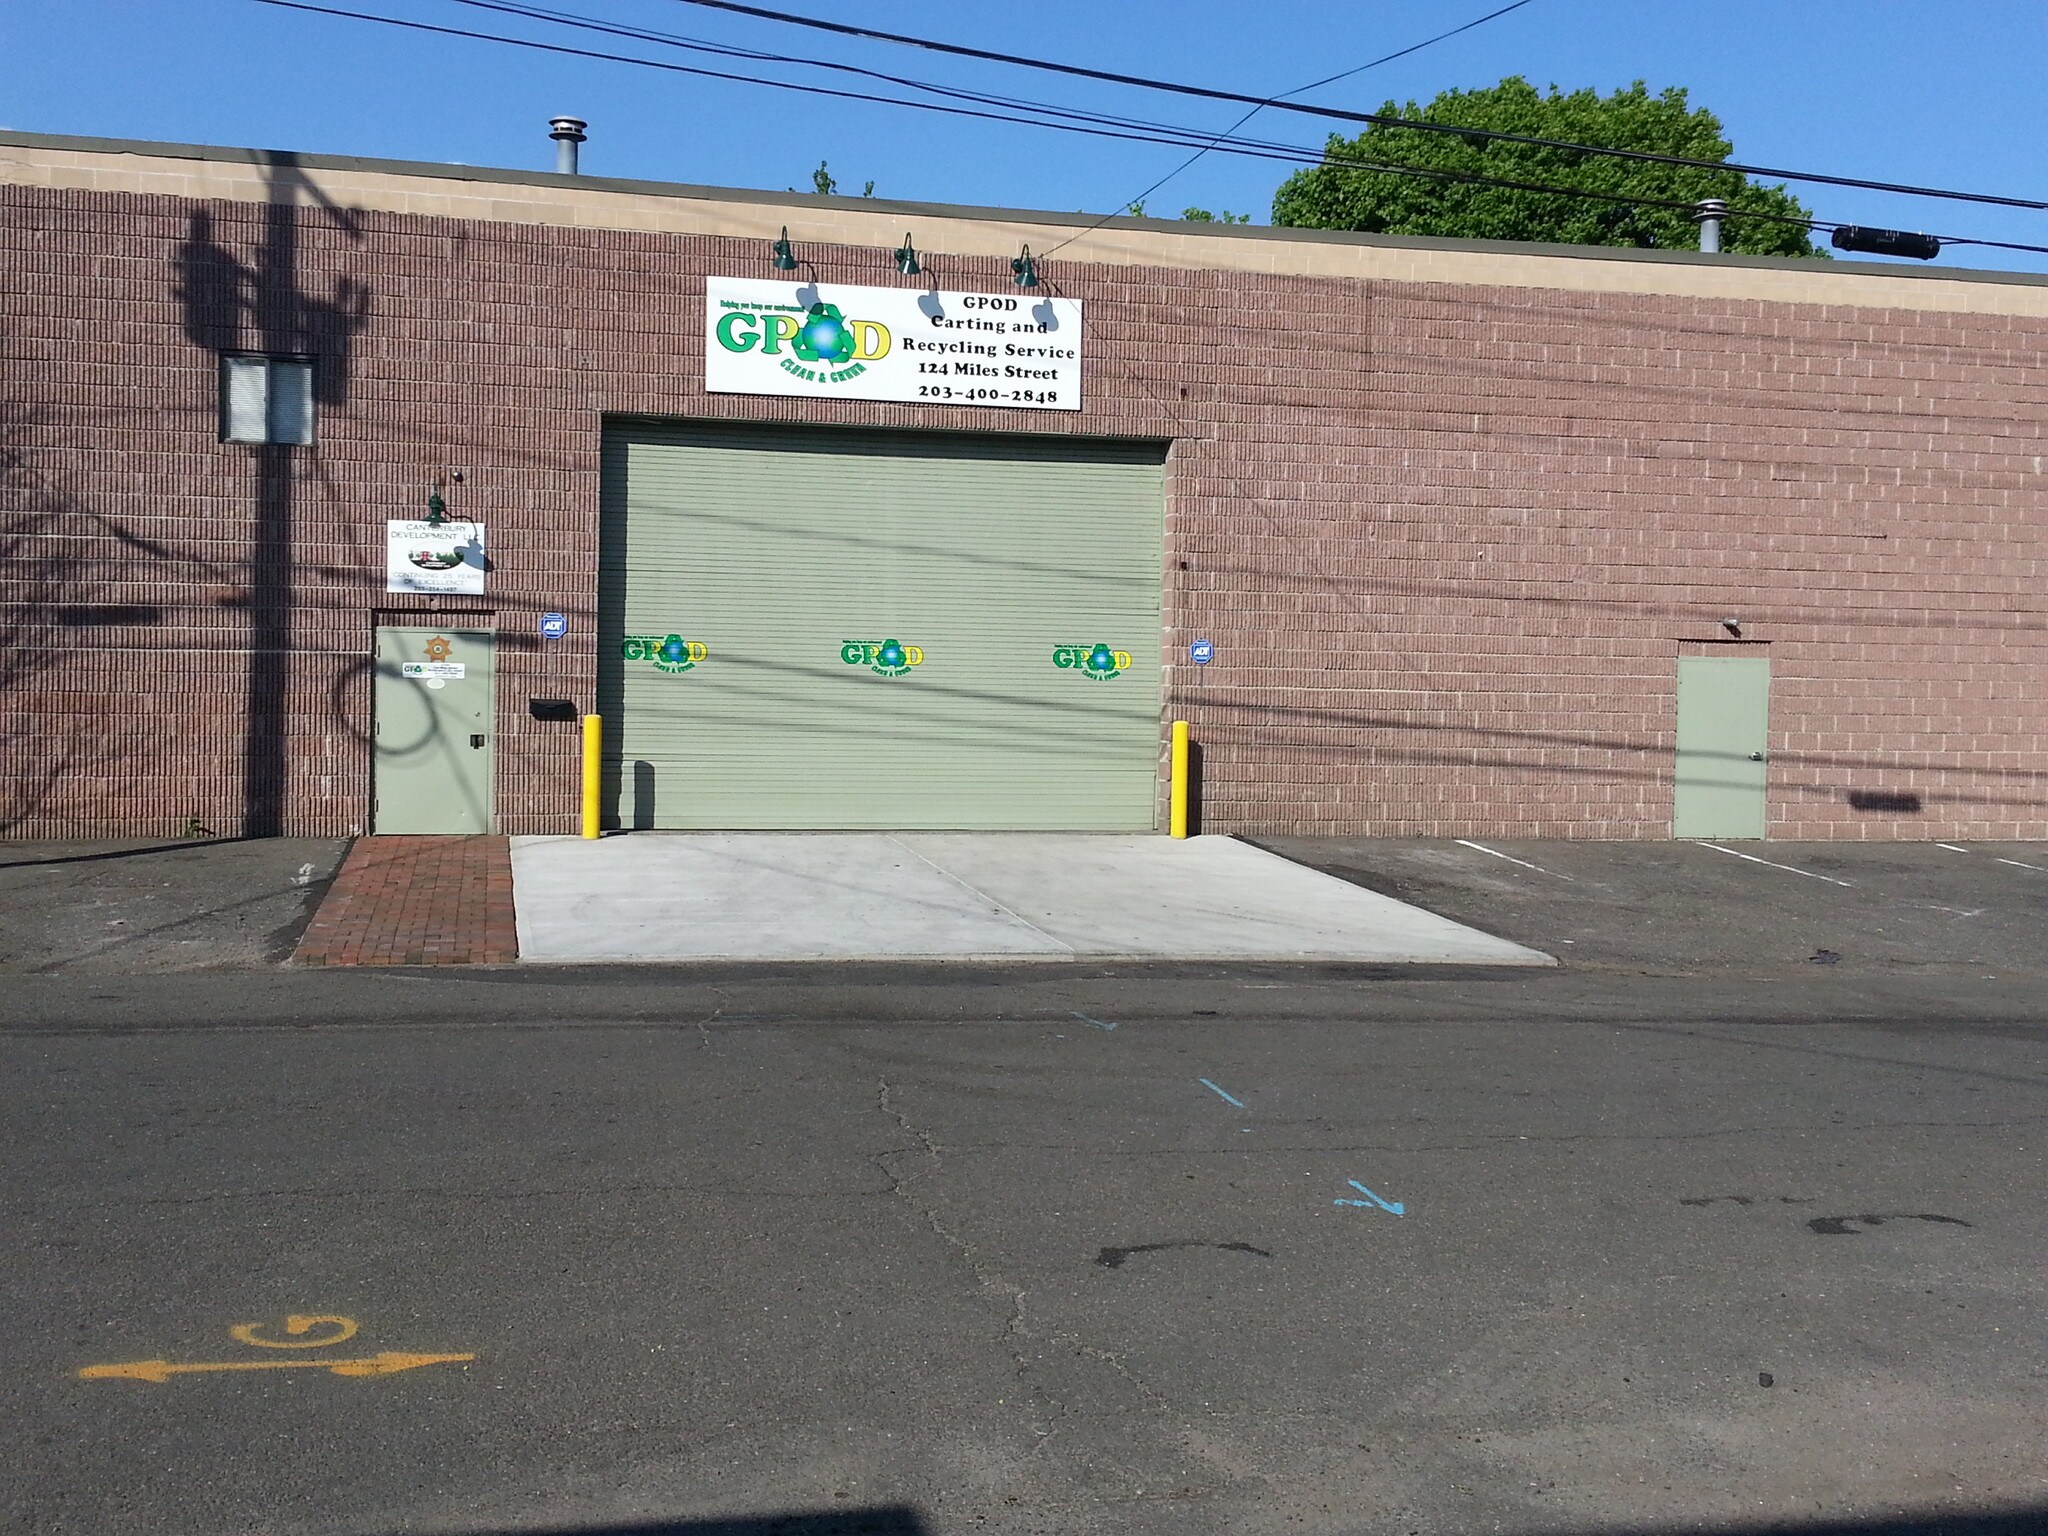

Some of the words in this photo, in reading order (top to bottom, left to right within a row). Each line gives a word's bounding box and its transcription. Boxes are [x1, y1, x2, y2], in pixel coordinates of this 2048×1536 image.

[963, 297, 1017, 311] GPOD
[931, 315, 1006, 334] Carting
[1012, 322, 1048, 334] and
[903, 338, 997, 358] Recycling
[1004, 343, 1075, 359] Service
[780, 358, 815, 381] CLEAN
[818, 372, 826, 383] &
[830, 362, 867, 383] GREEN
[918, 362, 948, 376] 124
[954, 363, 999, 377] Miles
[1004, 365, 1058, 380] Street
[918, 386, 1057, 404] 203-400-2848
[391, 531, 458, 540] DEVELOPMENT
[543, 621, 563, 630] ADT
[1193, 646, 1210, 656] ADT
